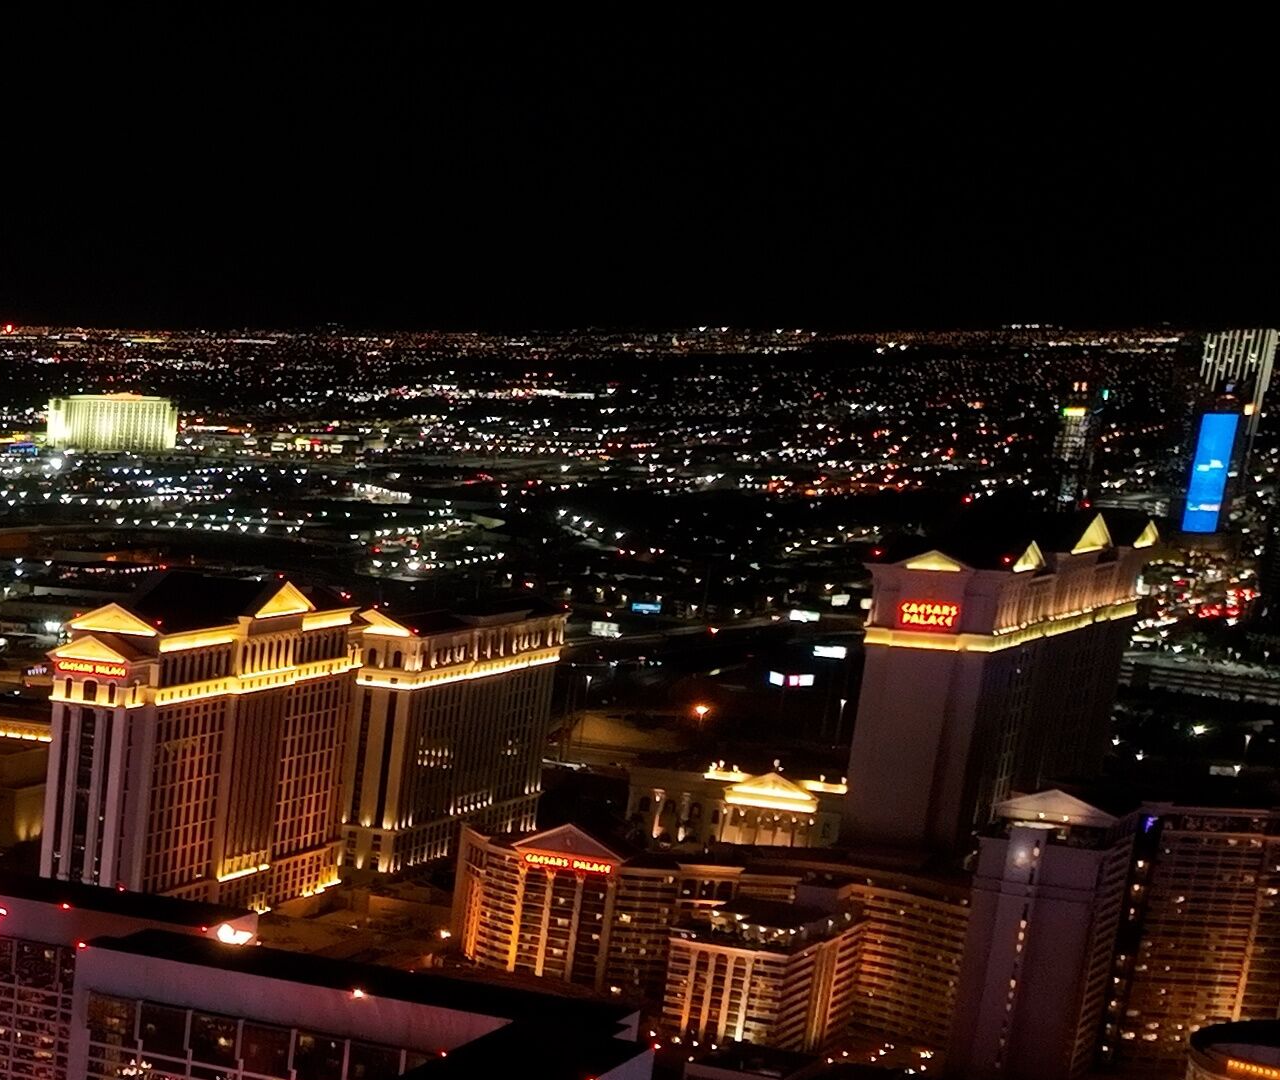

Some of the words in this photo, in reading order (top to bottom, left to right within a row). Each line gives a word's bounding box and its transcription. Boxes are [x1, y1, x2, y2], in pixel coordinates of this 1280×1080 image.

[901, 603, 958, 617] CAESARS
[902, 613, 953, 627] PALACE
[525, 853, 569, 868] CAESARS
[573, 860, 611, 874] PALACE
